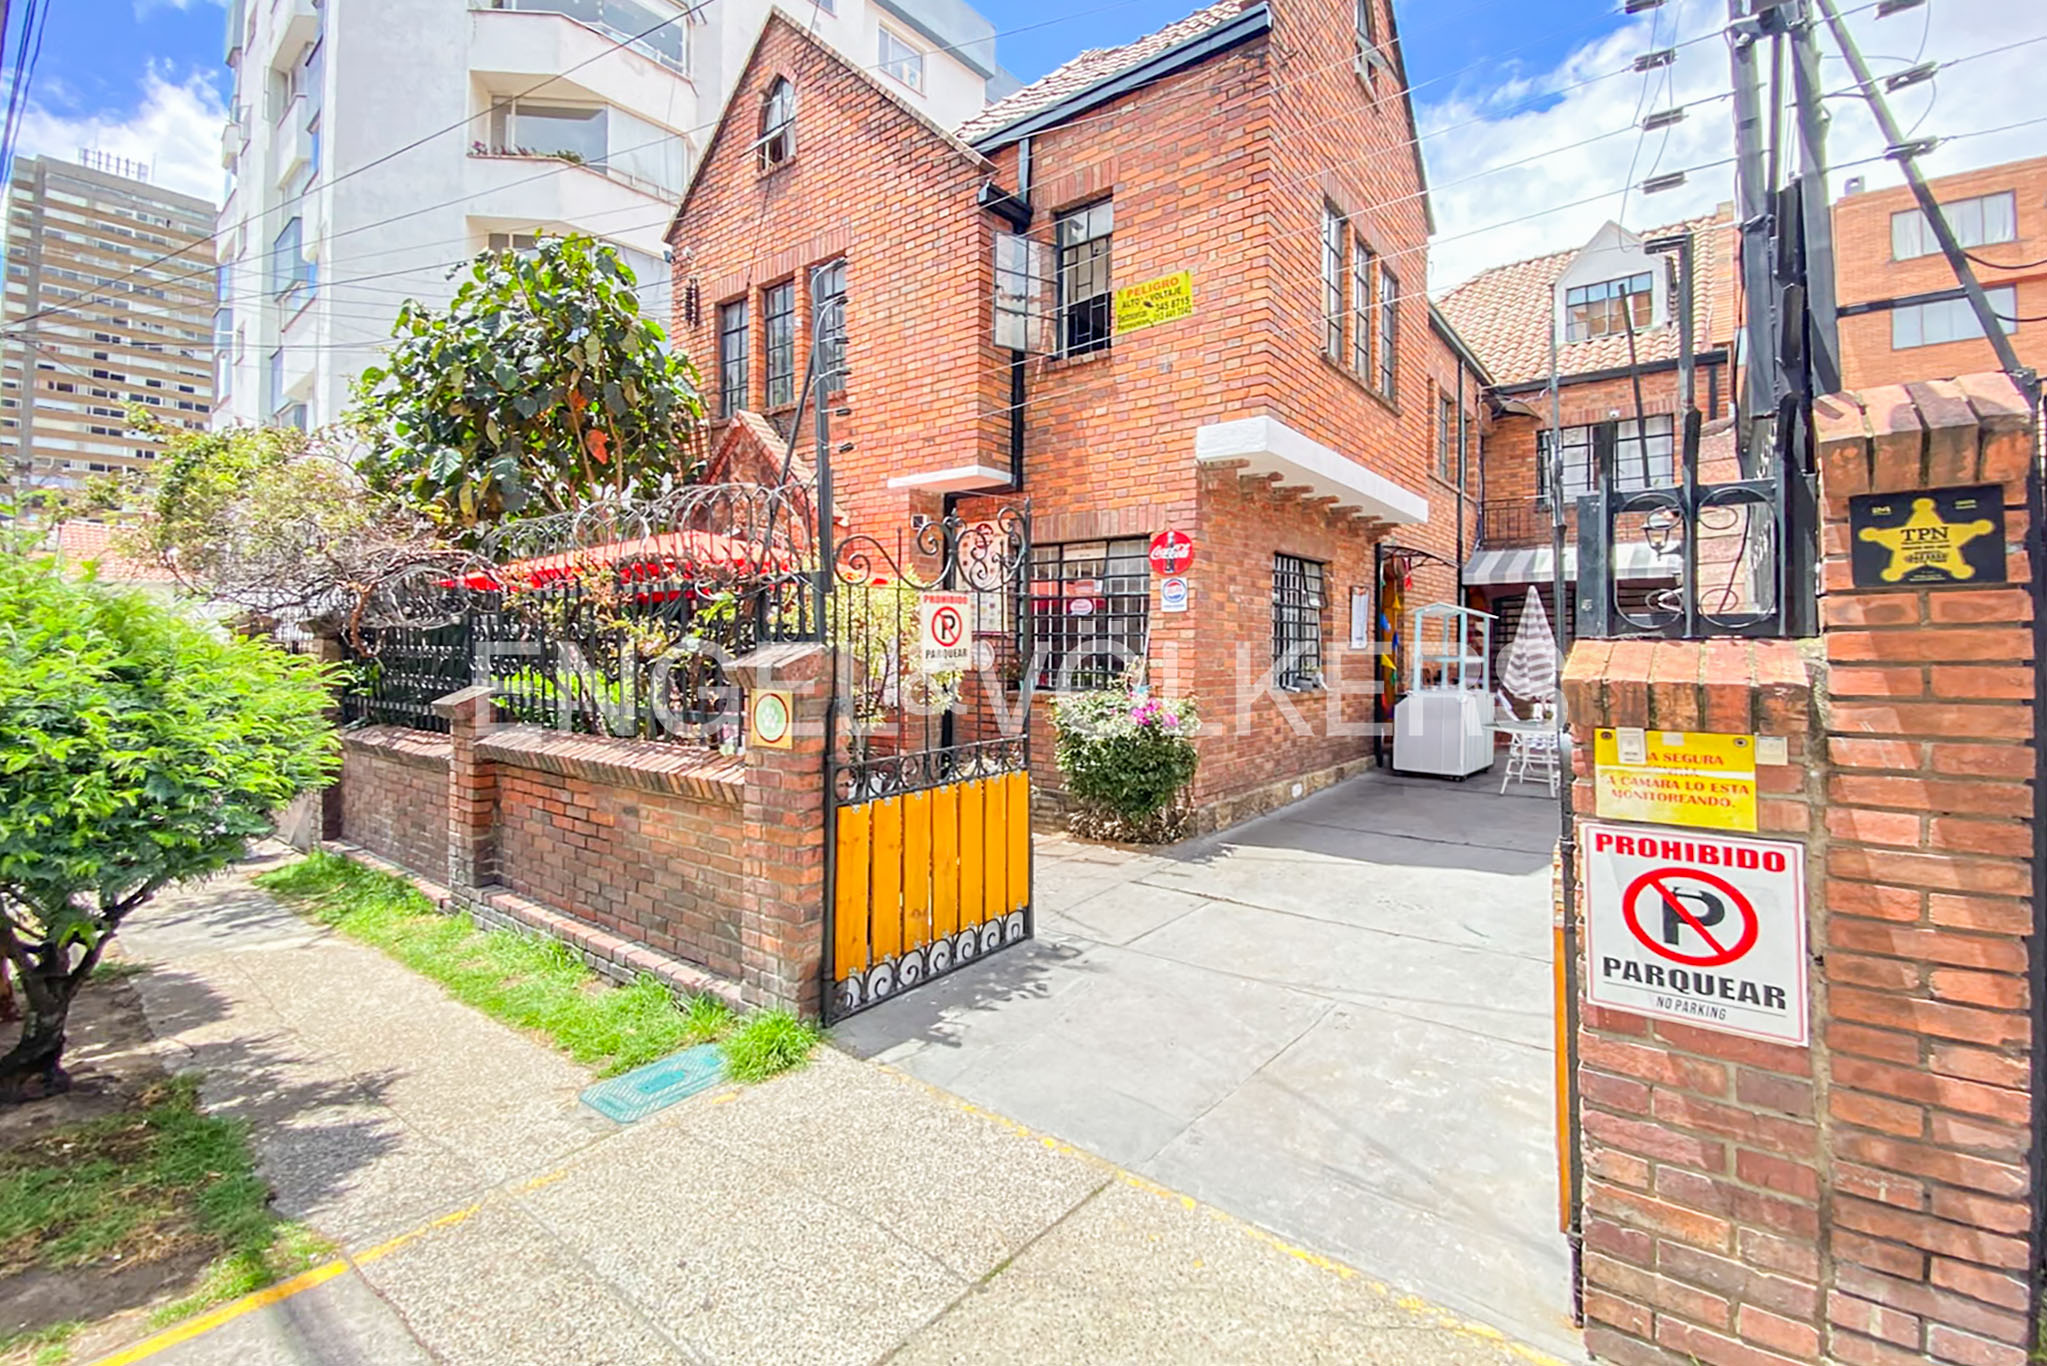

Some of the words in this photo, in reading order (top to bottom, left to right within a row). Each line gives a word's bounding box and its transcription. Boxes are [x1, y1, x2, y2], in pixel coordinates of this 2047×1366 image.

[1127, 277, 1179, 297] PELIGRO
[1900, 526, 1949, 541] TPN
[925, 648, 967, 660] PARQUEAR
[1663, 752, 1724, 766] SEGURA
[1621, 775, 1680, 789] CAMARA
[1685, 780, 1705, 791] LO
[1711, 783, 1749, 794] ESTA
[1595, 832, 1786, 873] PROHIBIDO
[1602, 956, 1787, 1010] PARQUEAR
[1656, 996, 1673, 1009] NO
[1675, 998, 1727, 1021] PARKING
